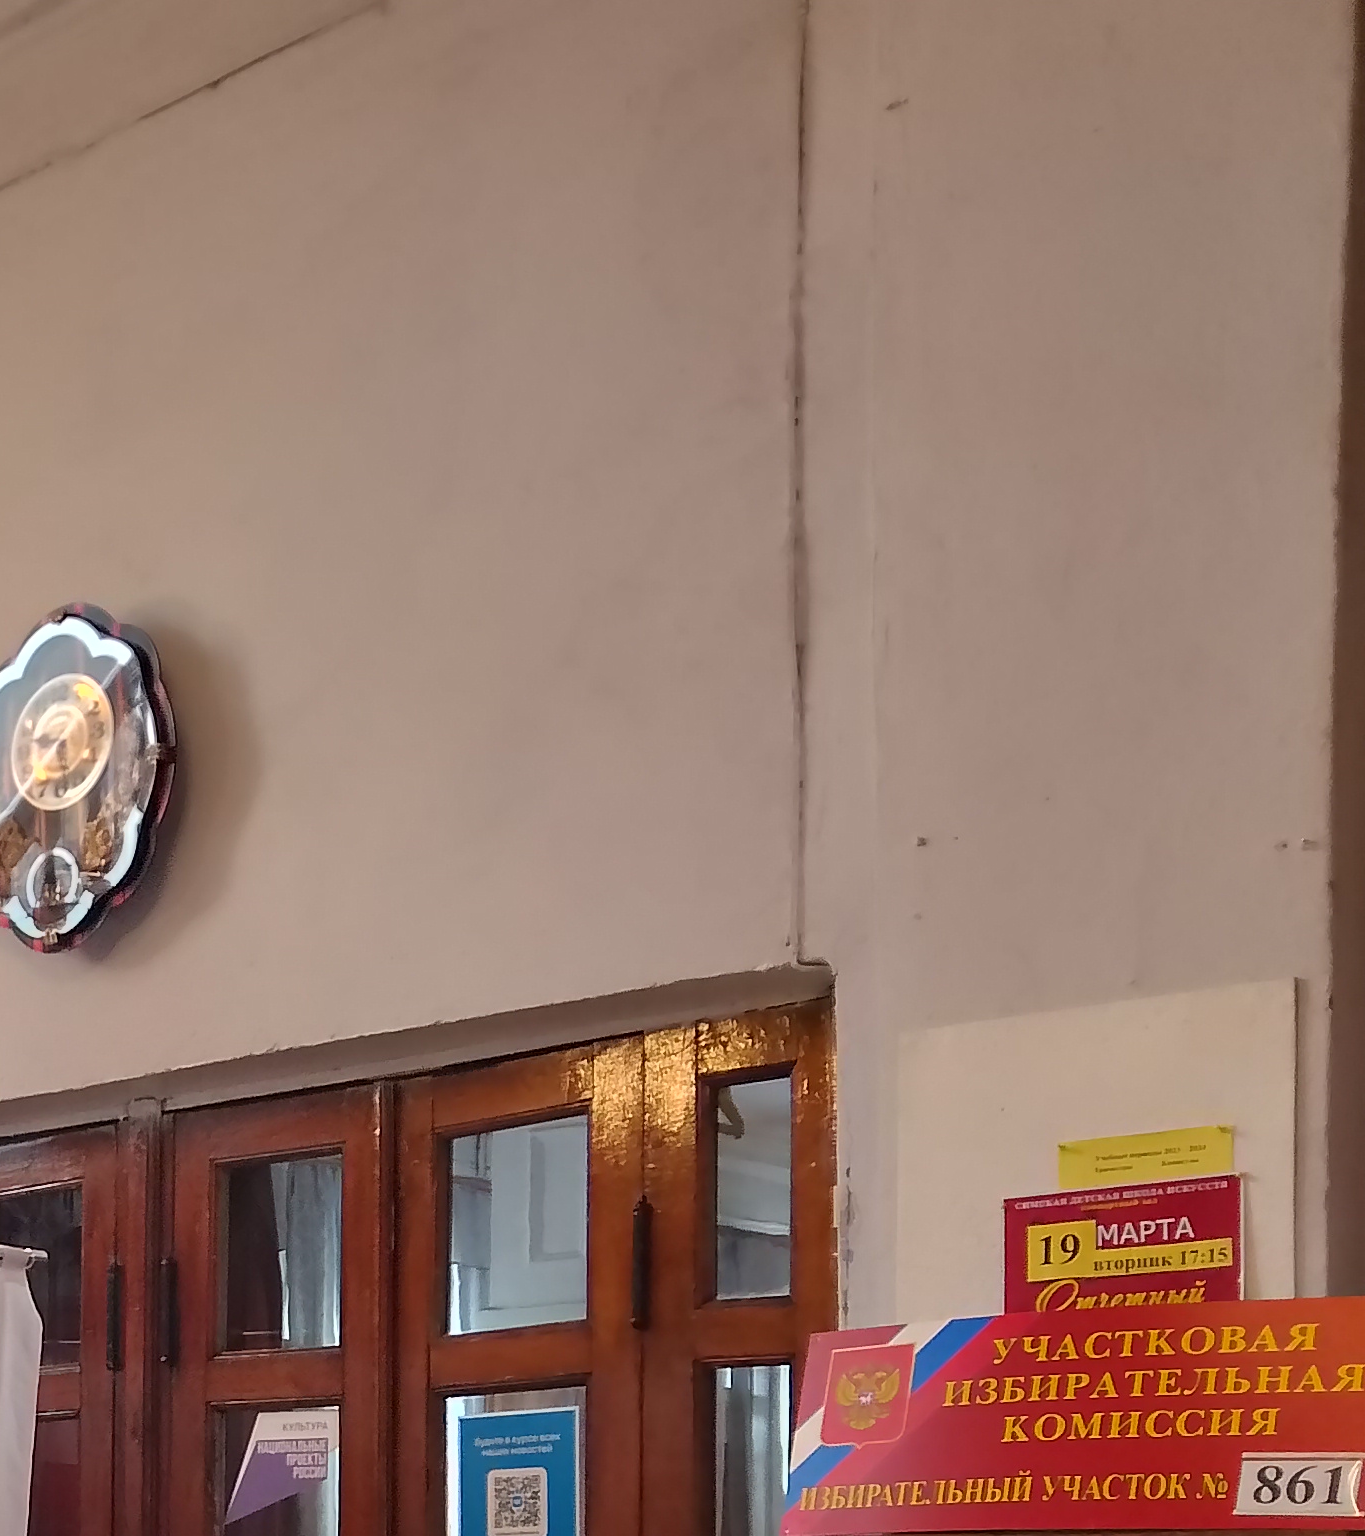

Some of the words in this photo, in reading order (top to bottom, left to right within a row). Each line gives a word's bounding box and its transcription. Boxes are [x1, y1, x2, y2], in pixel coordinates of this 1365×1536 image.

[1040, 1233, 1081, 1266] 19
[1097, 1216, 1195, 1247] МАРТА
[1093, 1255, 1172, 1273] вторник
[1180, 1247, 1229, 1266] 17:15
[992, 1322, 1321, 1365] УЧАСТКОВАЯ
[942, 1362, 1365, 1408] ИЗБИРАТЕЛЬНАЯ
[282, 1420, 329, 1432] КУЛЬТУРА
[1000, 1407, 1281, 1443] КОМИССИЯ
[257, 1440, 327, 1454] НАЦИОНАЛЬНЫЕ
[286, 1453, 327, 1466] ПРОЕКТЫ
[1041, 1472, 1188, 1503] УЧАСТОК
[1195, 1472, 1229, 1500] №
[1252, 1463, 1343, 1507] 861
